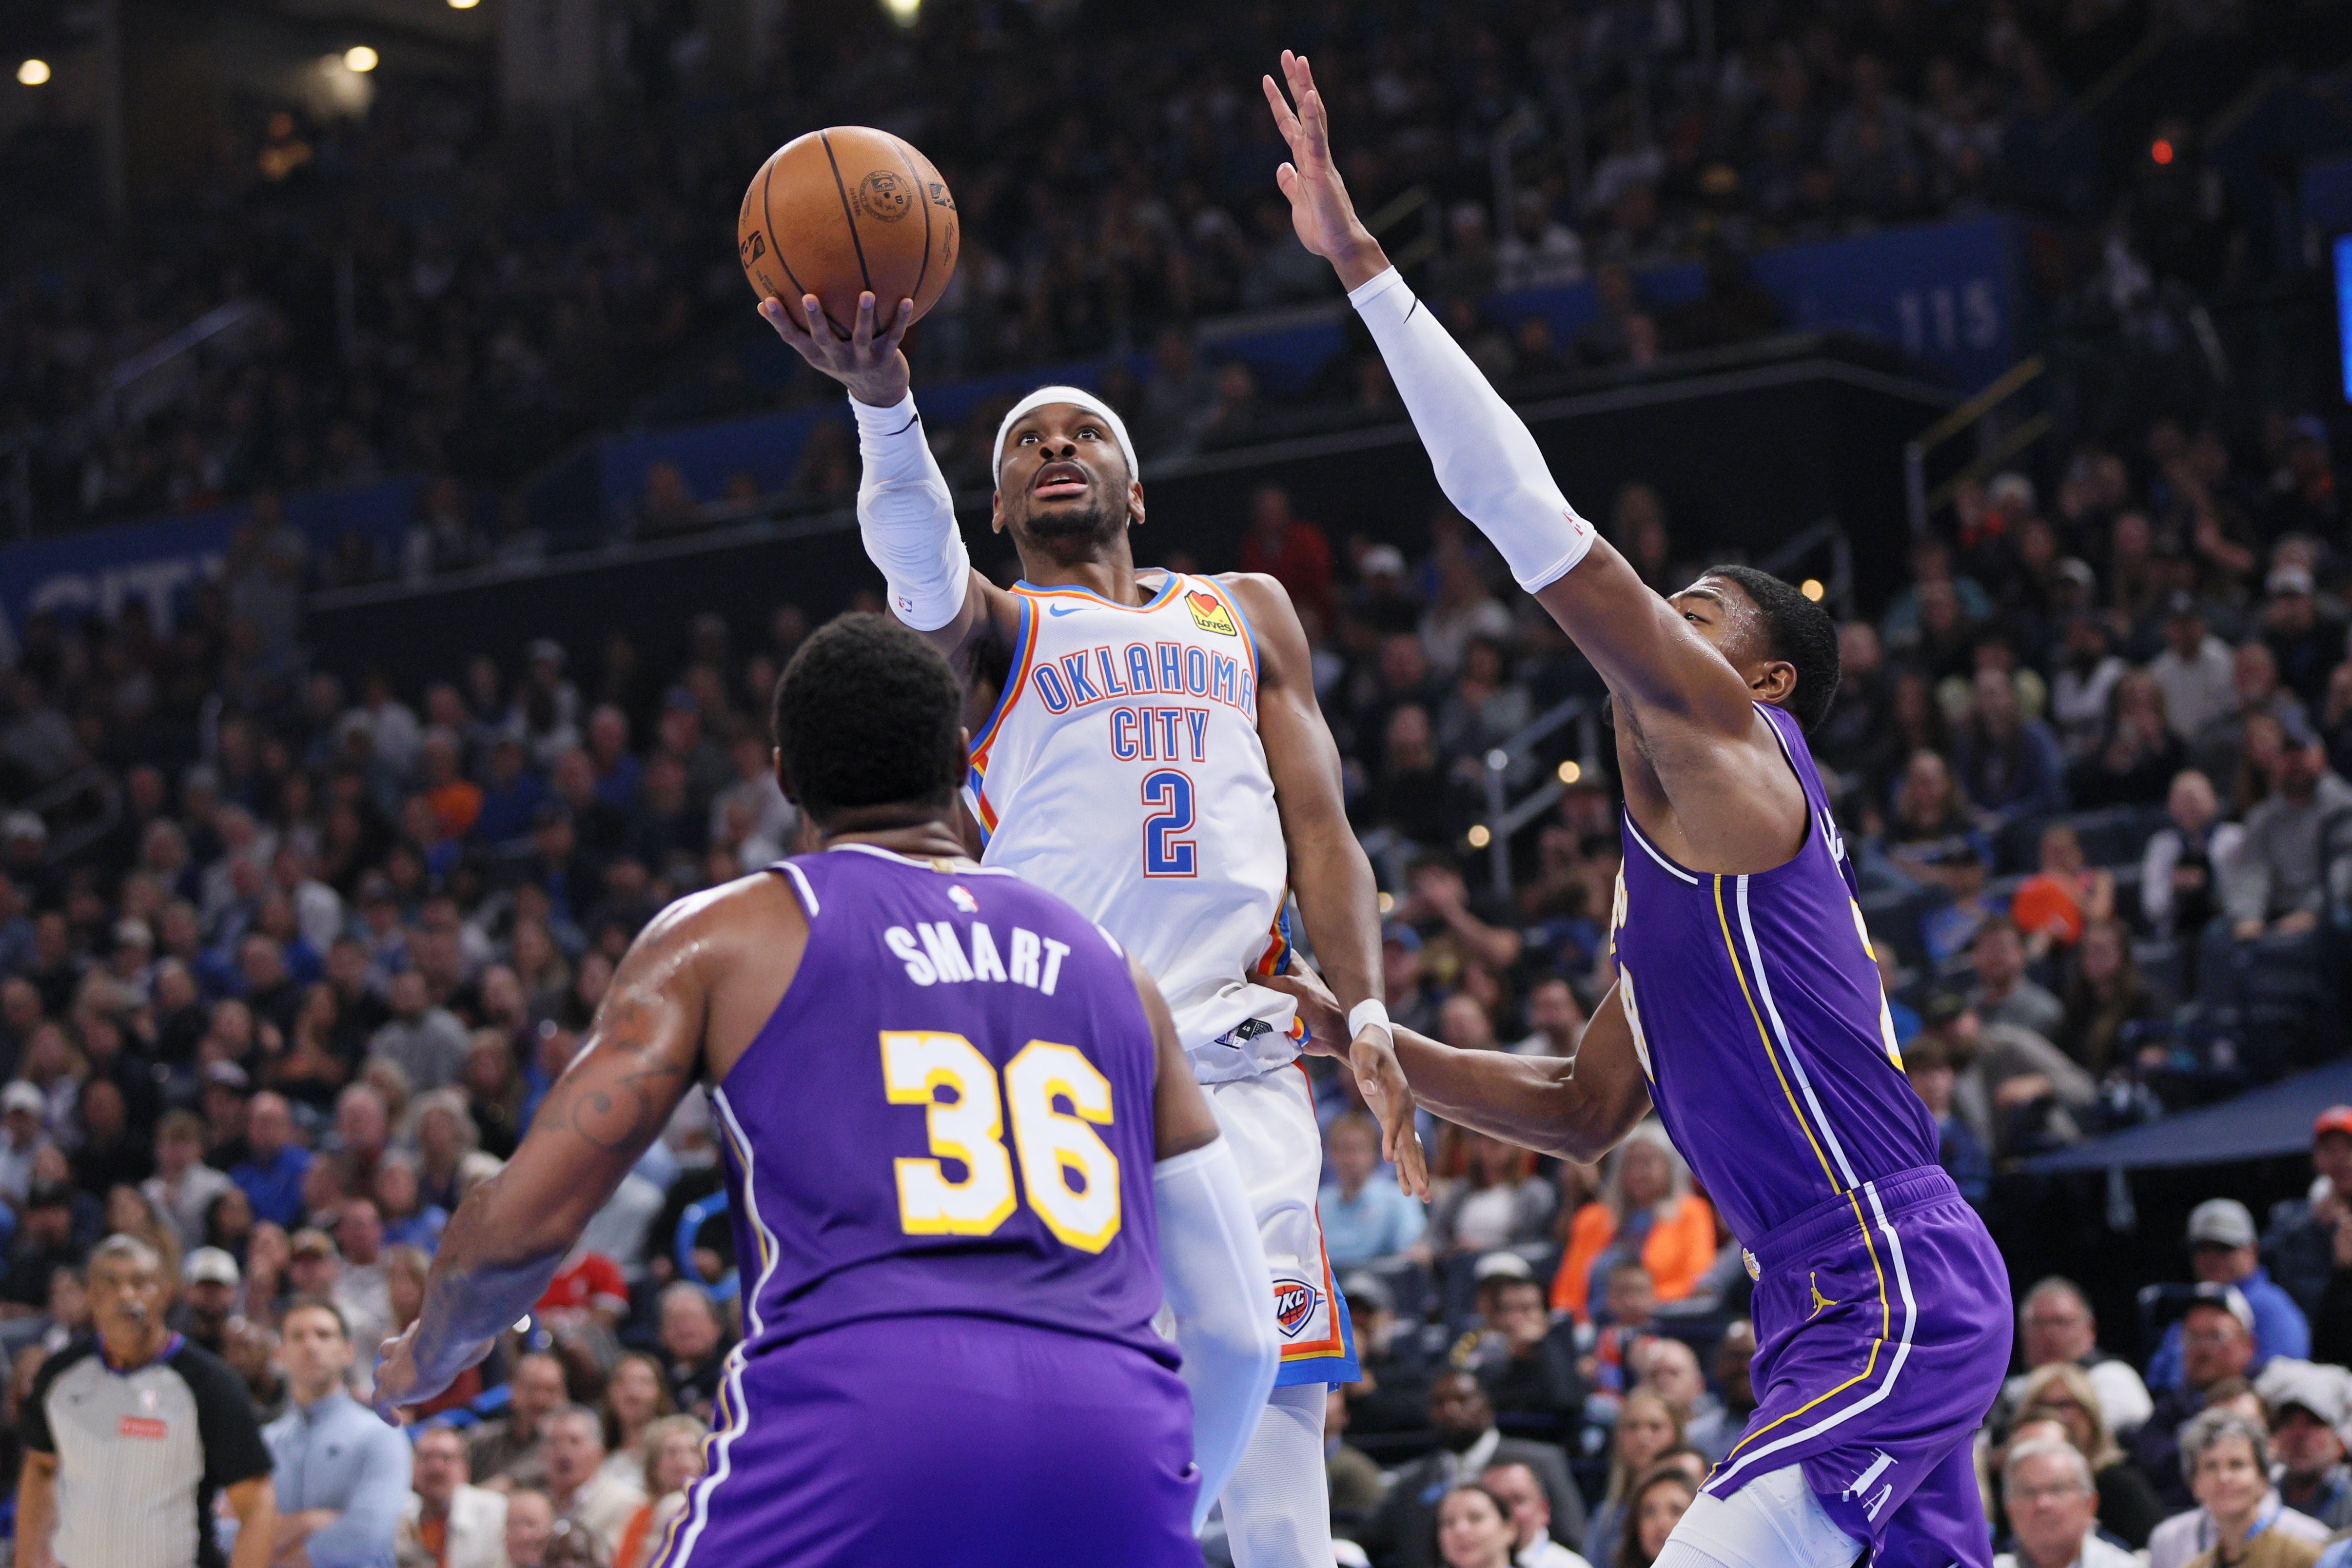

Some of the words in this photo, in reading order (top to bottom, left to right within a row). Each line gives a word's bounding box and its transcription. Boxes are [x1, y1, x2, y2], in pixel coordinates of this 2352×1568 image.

[1031, 642, 1257, 721] OKLAHOMA
[1110, 706, 1210, 763] CITY
[1141, 767, 1197, 878] 2
[883, 921, 1071, 996] SMART
[879, 1029, 1121, 1254] 36
